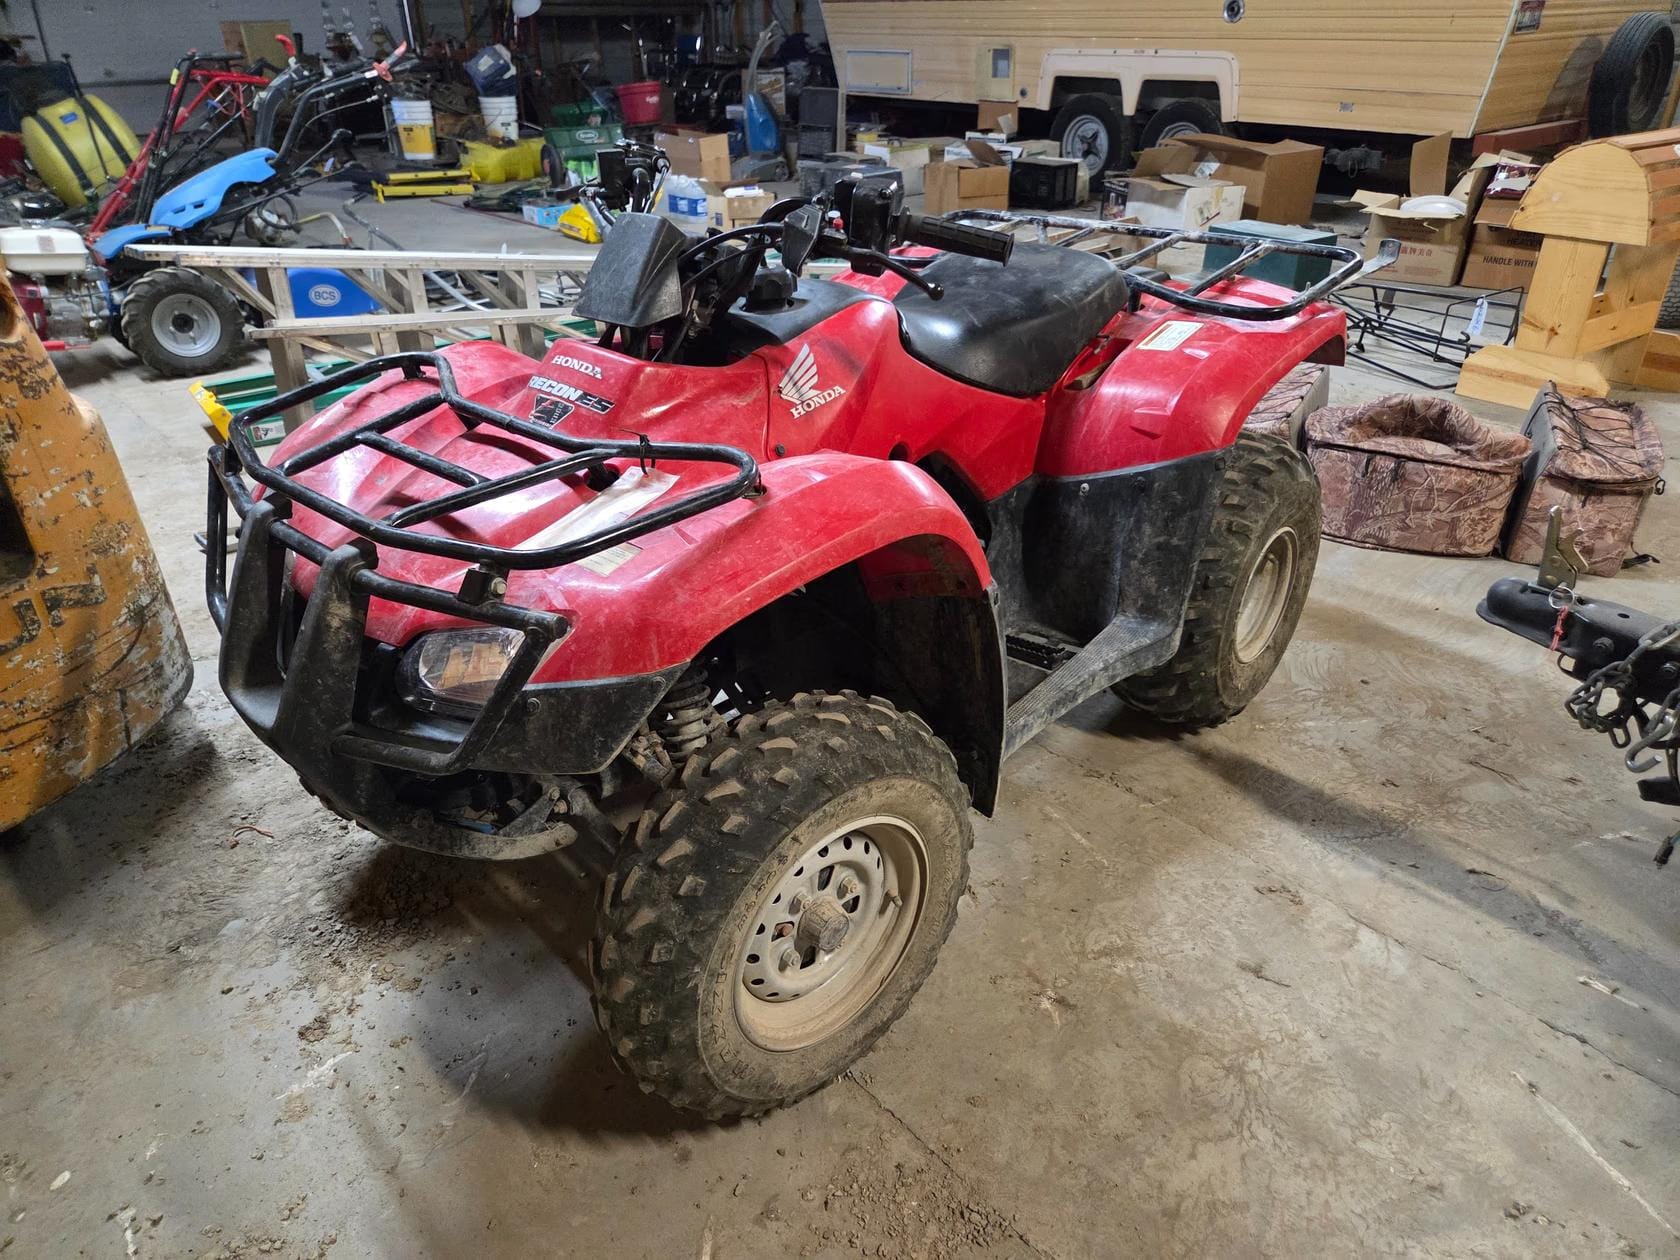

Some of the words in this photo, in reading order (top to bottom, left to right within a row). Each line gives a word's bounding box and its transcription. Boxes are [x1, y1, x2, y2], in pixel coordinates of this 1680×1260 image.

[1482, 256, 1513, 265] HANDLE
[1514, 258, 1534, 268] WITH
[314, 290, 336, 301] BCS
[551, 355, 602, 379] HONDA
[529, 376, 583, 401] RECON
[790, 386, 846, 419] HONDA
